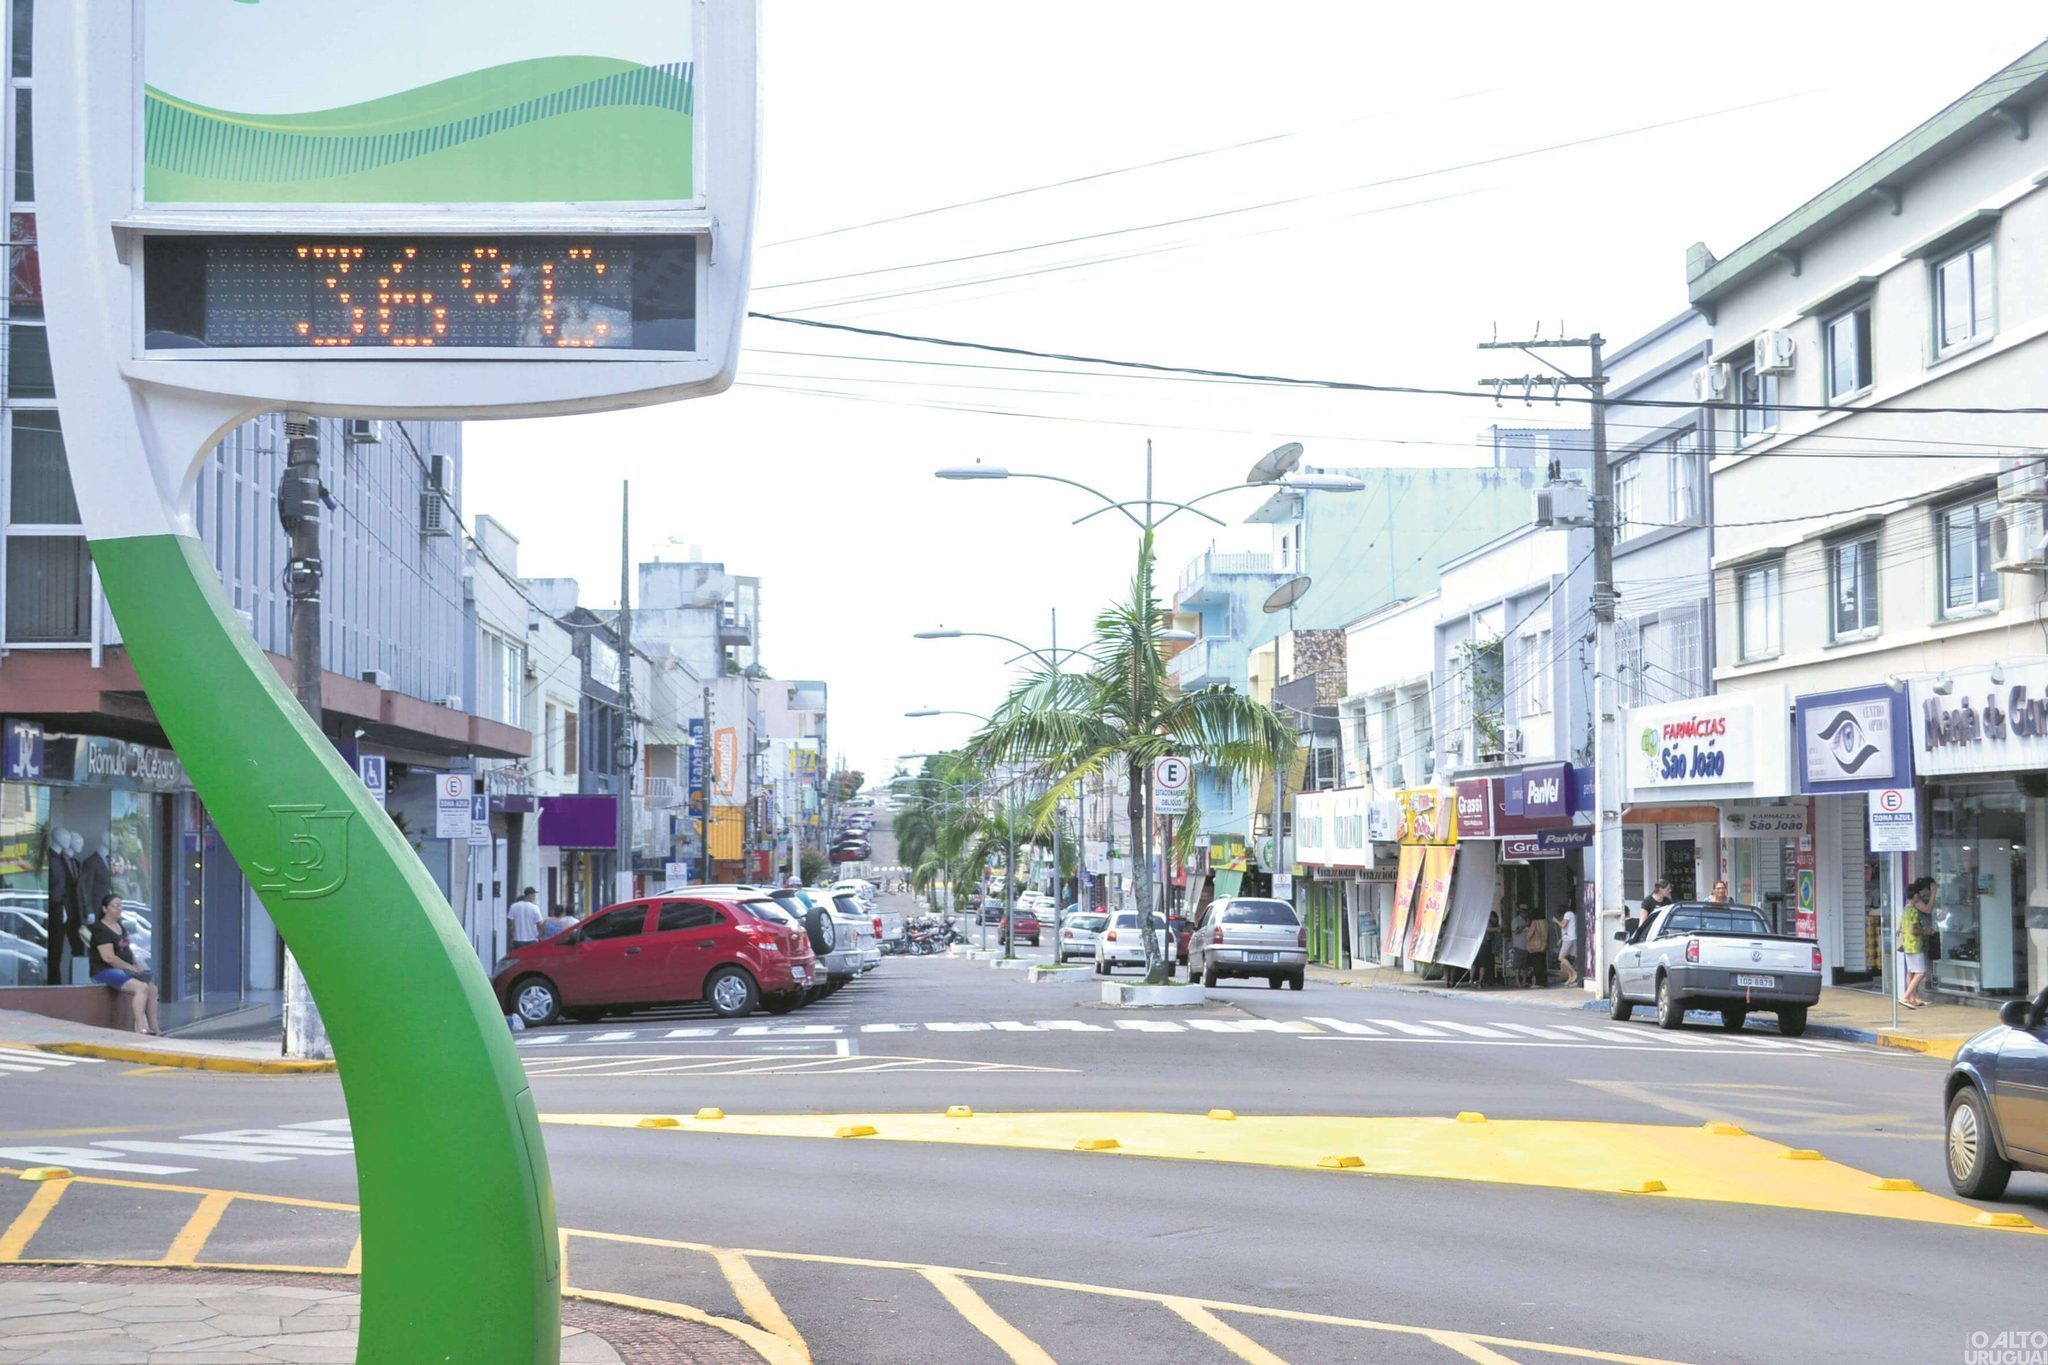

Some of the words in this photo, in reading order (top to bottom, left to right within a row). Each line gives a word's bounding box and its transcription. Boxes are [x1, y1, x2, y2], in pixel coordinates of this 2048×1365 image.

[297, 247, 609, 347] 36°C
[1663, 716, 1726, 740] FARMÁCIAS
[88, 741, 127, 776] Rômulo
[690, 725, 704, 788] itapema
[1661, 743, 1687, 780] São
[1690, 739, 1725, 778] João
[1168, 765, 1177, 781] E
[450, 780, 458, 793] E
[1458, 794, 1483, 814] Grassi
[1887, 794, 1897, 807] E
[1749, 820, 1772, 831] São
[1774, 820, 1803, 831] João
[1894, 813, 1912, 821] AZUL
